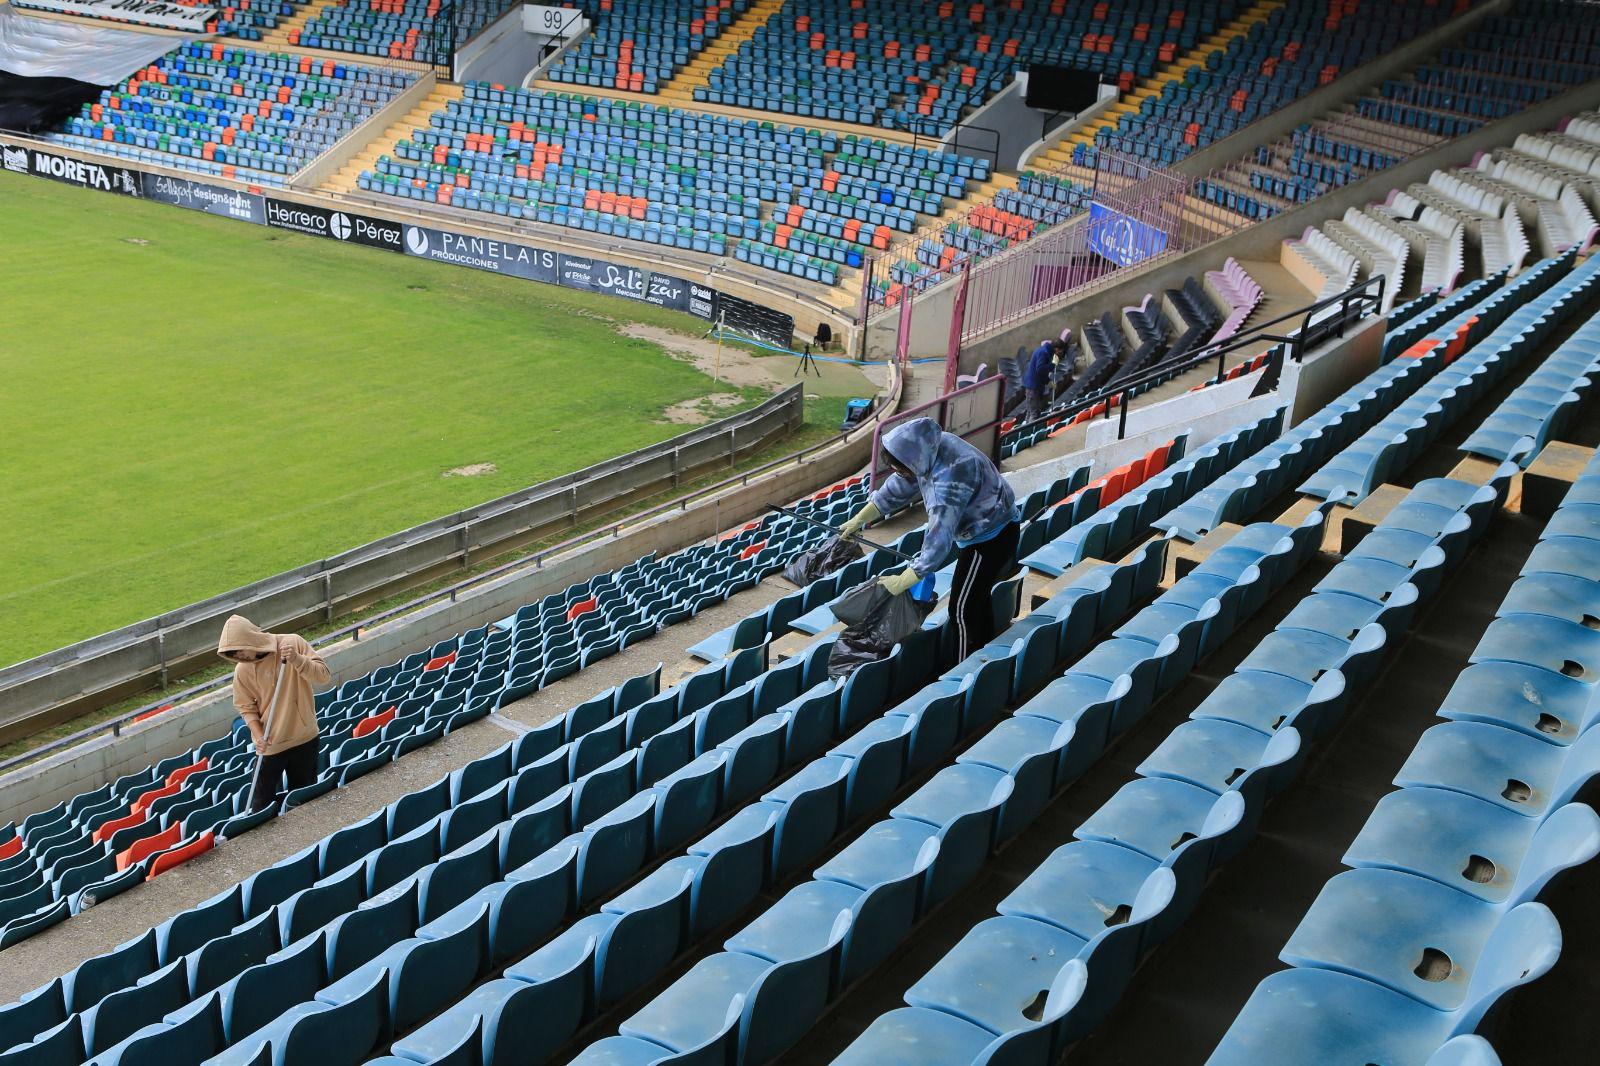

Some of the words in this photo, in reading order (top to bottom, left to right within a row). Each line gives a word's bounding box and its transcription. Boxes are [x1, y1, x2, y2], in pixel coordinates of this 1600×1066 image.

[545, 10, 561, 29] 99
[35, 153, 110, 190] MORETA
[267, 201, 327, 229] Herrero
[356, 218, 401, 245] Pérez
[431, 249, 498, 270] PRODUCCIONES
[442, 233, 554, 268] PANELAIS
[653, 276, 671, 285] DAVID
